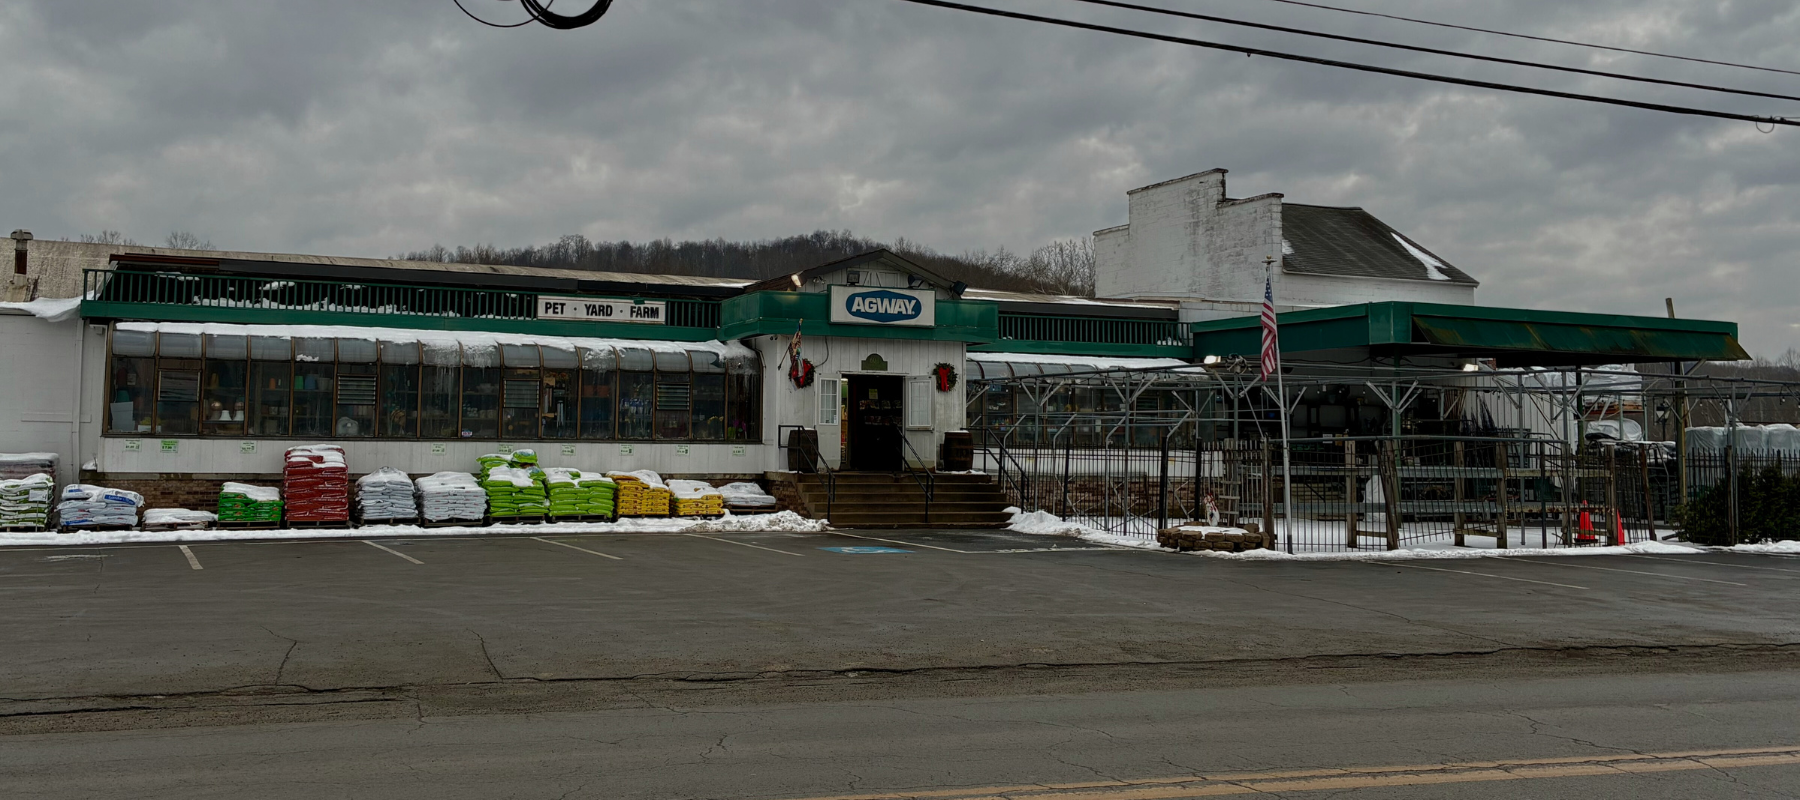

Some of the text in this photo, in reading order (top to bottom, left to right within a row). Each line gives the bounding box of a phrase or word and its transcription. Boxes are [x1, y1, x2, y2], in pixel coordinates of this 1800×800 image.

[545, 302, 660, 319] PET YARD FARM
[851, 297, 917, 315] AGWAY
